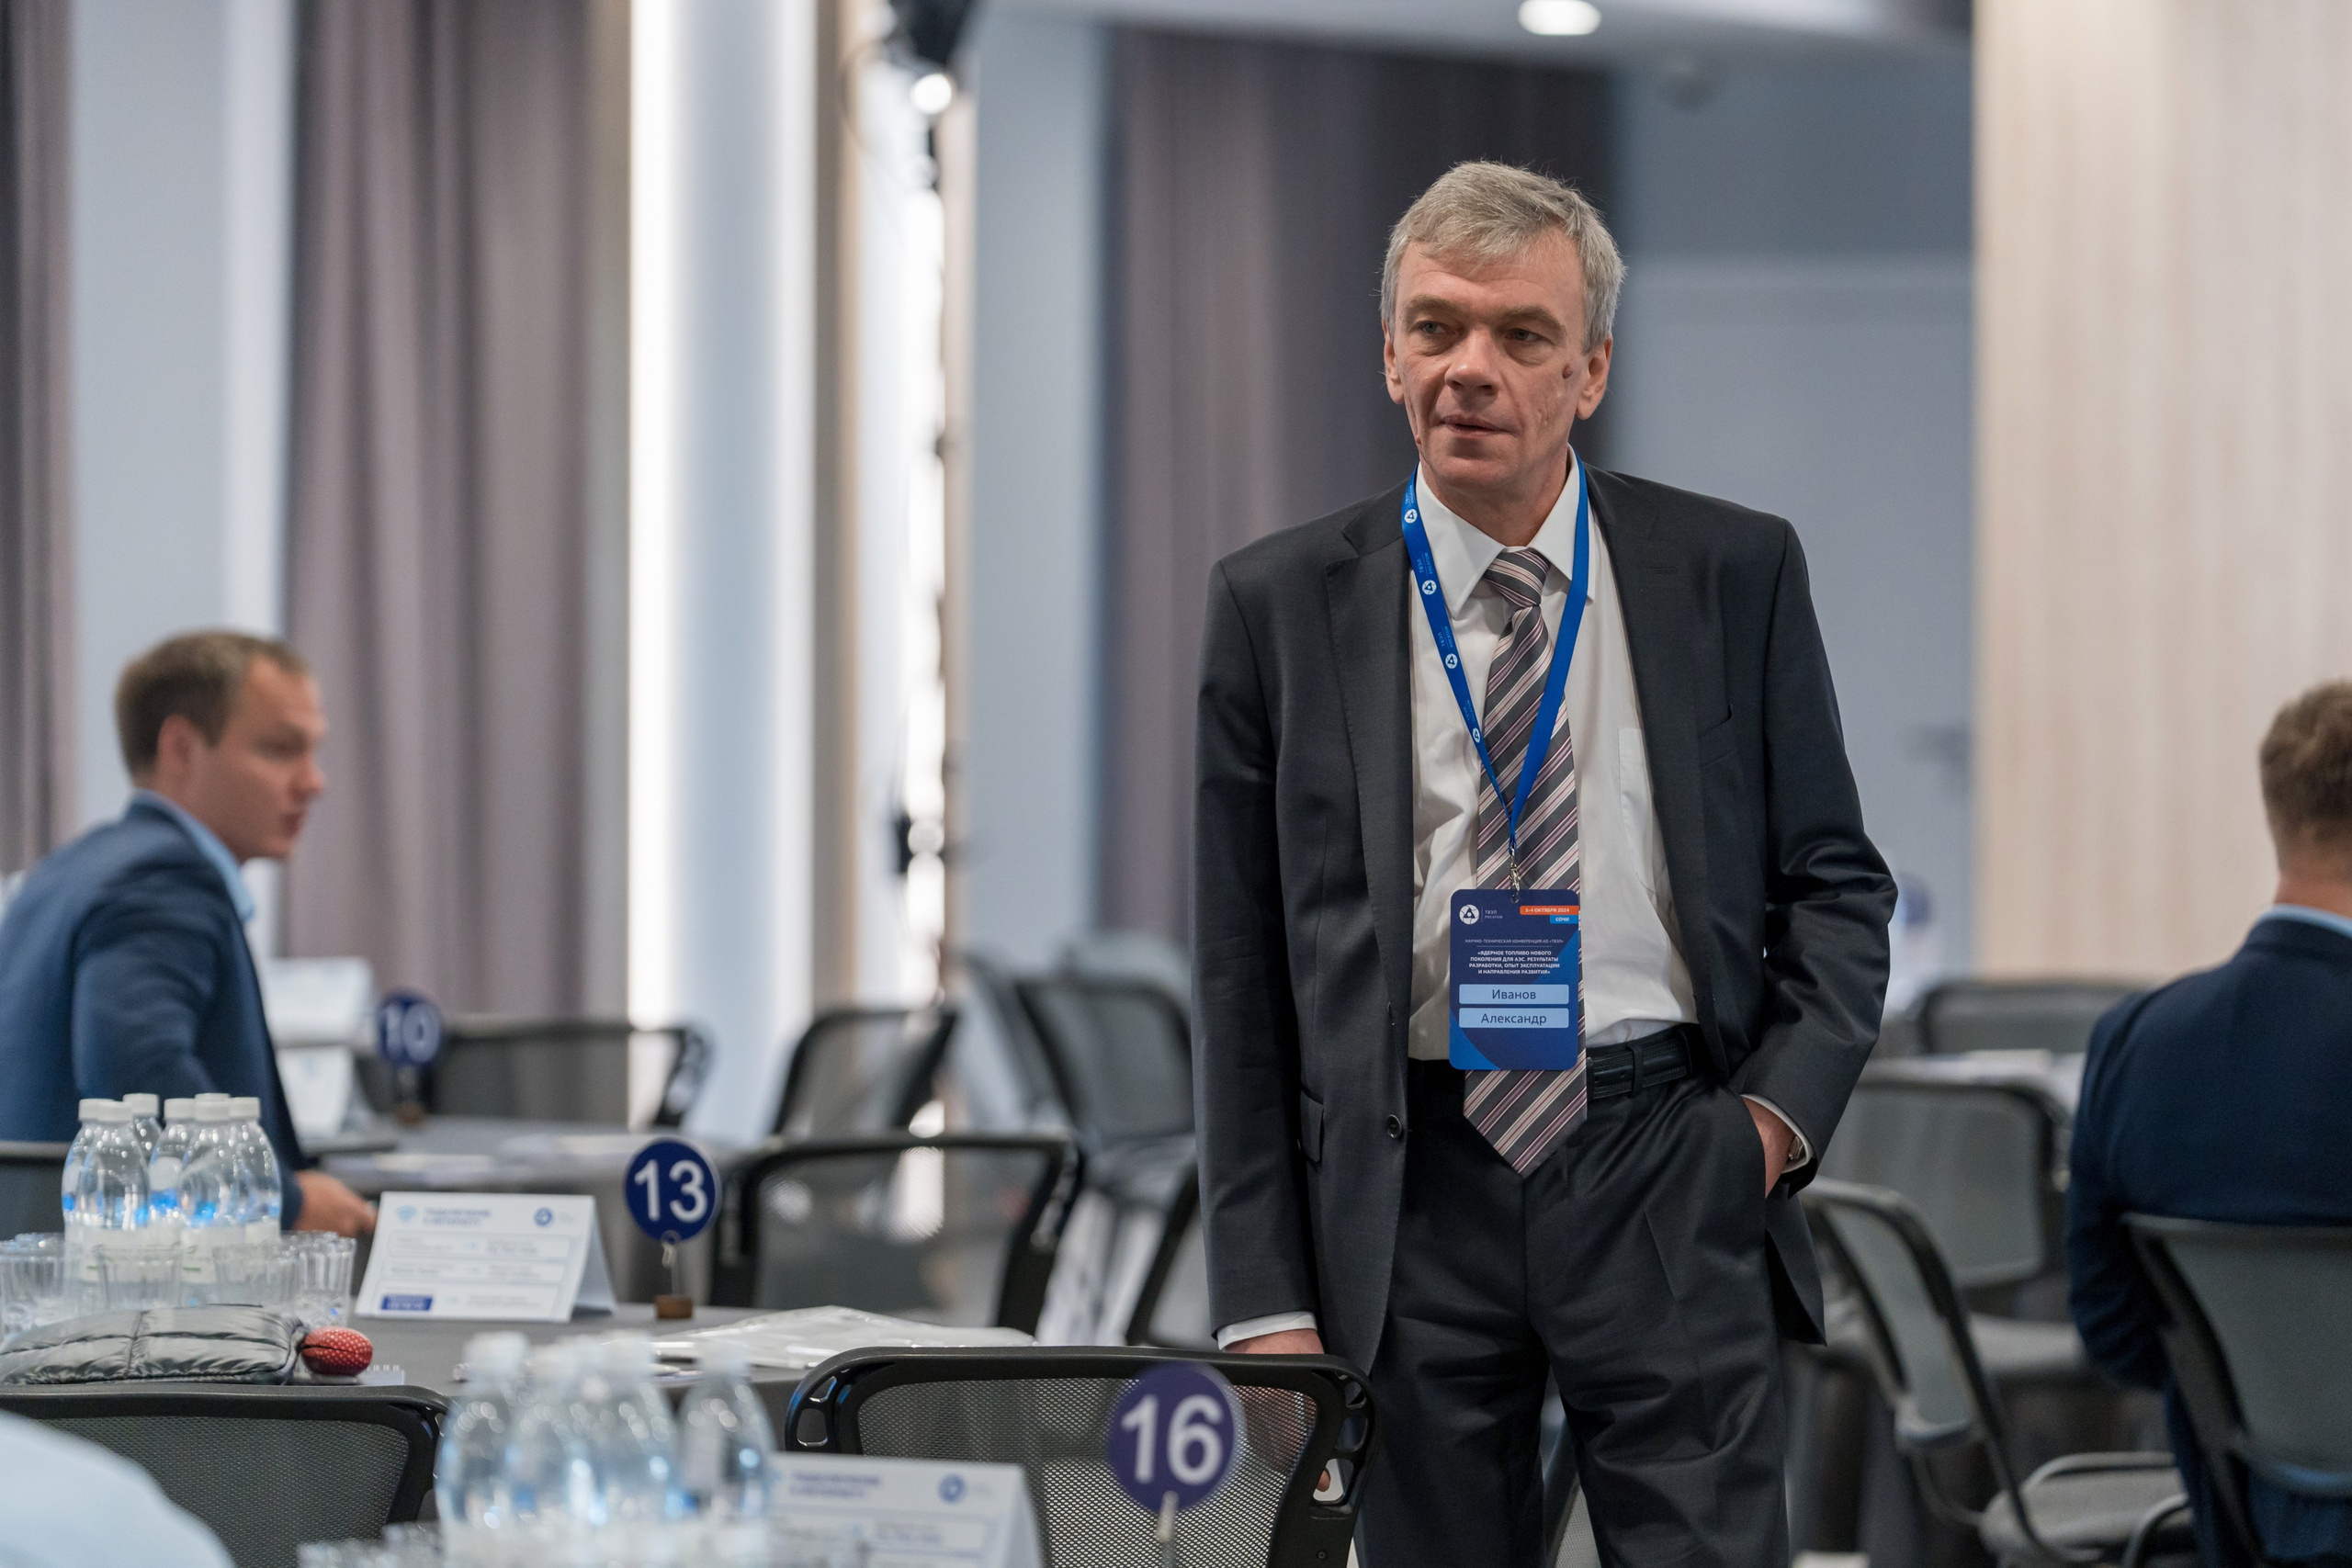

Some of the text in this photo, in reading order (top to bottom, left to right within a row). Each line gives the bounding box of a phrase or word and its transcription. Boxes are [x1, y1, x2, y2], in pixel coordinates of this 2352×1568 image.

[1481, 1013, 1547, 1026] Александр
[1492, 989, 1536, 999] Иванов
[380, 1001, 440, 1063] 10
[634, 1158, 708, 1223] 13
[1121, 1393, 1224, 1485] 16
